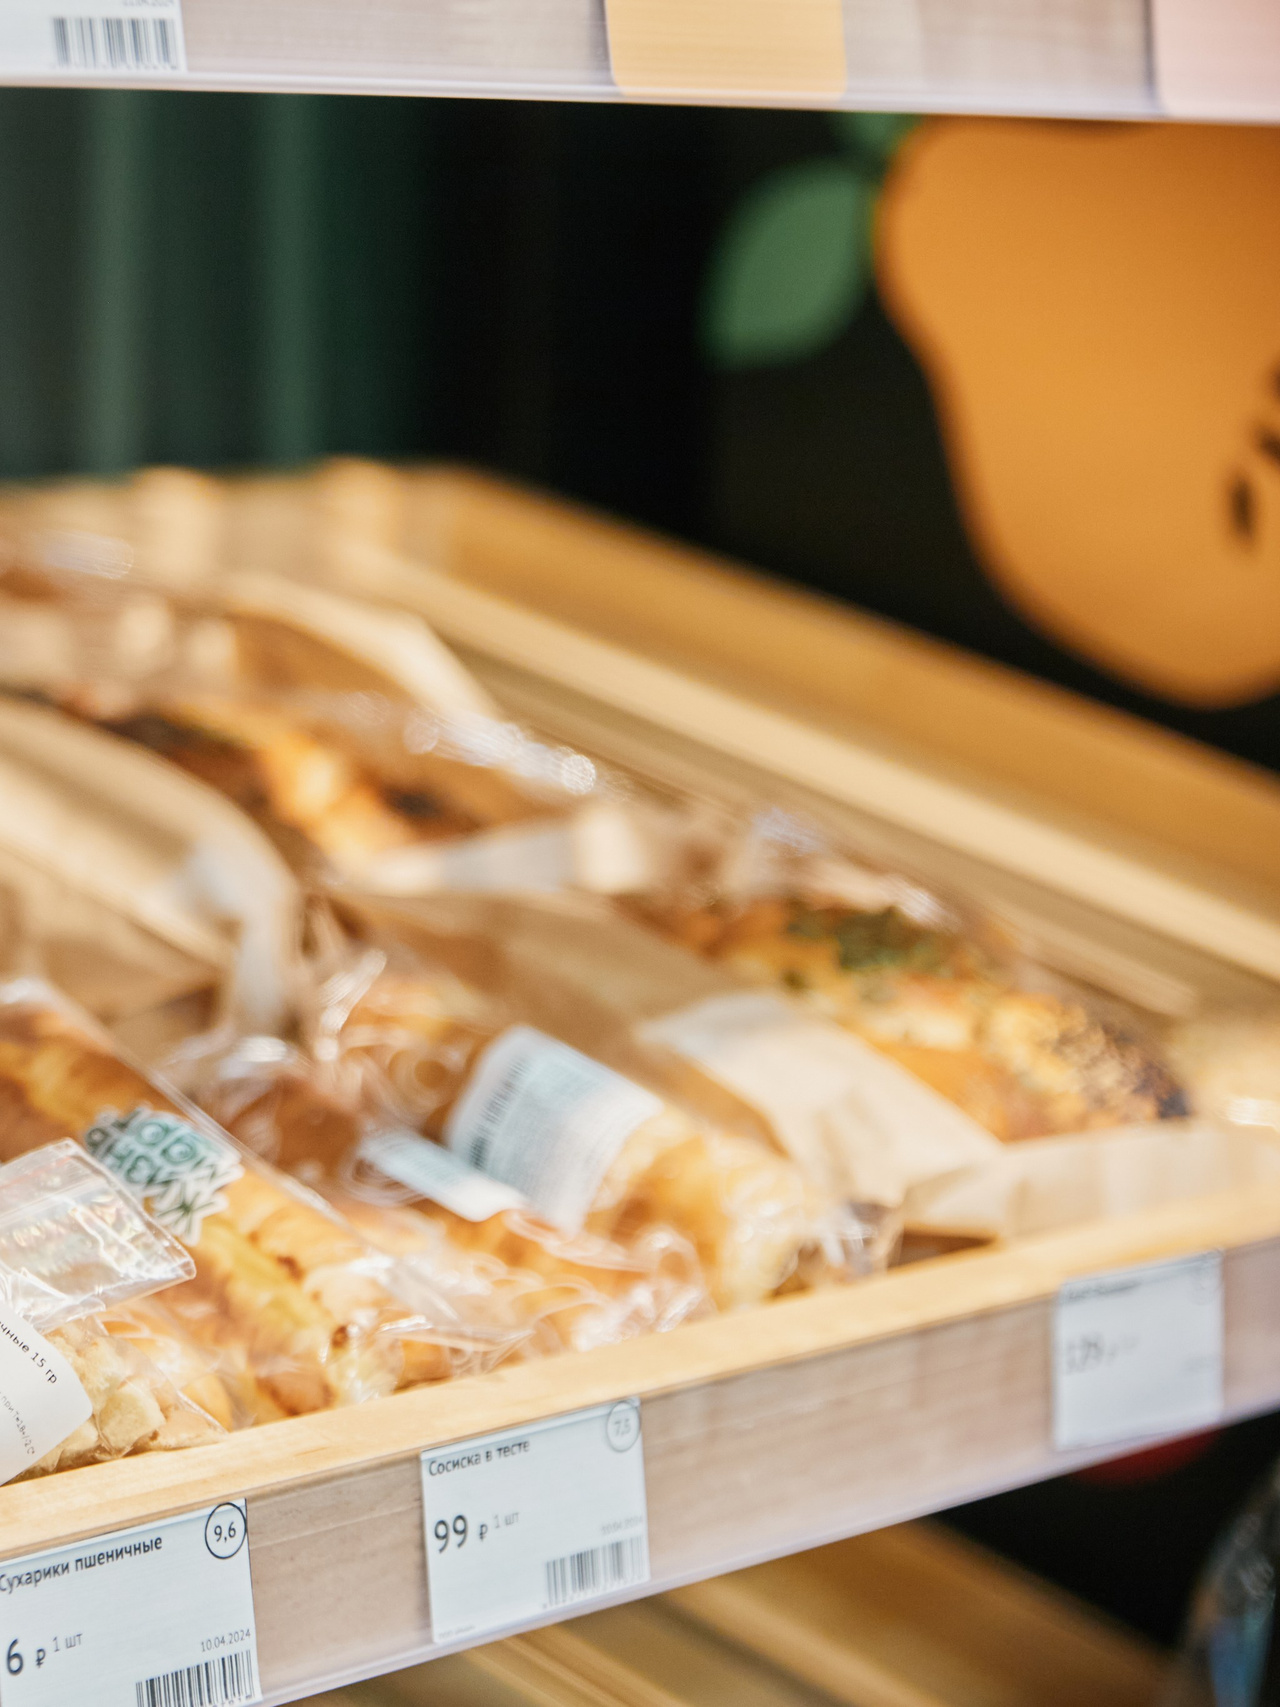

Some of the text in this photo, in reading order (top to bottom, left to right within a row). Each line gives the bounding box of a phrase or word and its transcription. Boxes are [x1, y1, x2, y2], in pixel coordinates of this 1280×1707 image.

[31, 1352, 47, 1368] 15
[45, 1368, 57, 1384] гр
[1, 1395, 15, 1412] при
[428, 1440, 530, 1477] Сосиска в тесте
[213, 1521, 237, 1543] 9,6
[434, 1514, 469, 1554] 99
[504, 1511, 521, 1527] шт
[74, 1536, 163, 1572] пшеничные
[6, 1638, 24, 1676] 6
[52, 1636, 60, 1653] 1
[65, 1632, 83, 1649] шт
[200, 1628, 252, 1653] 10.04.2024
